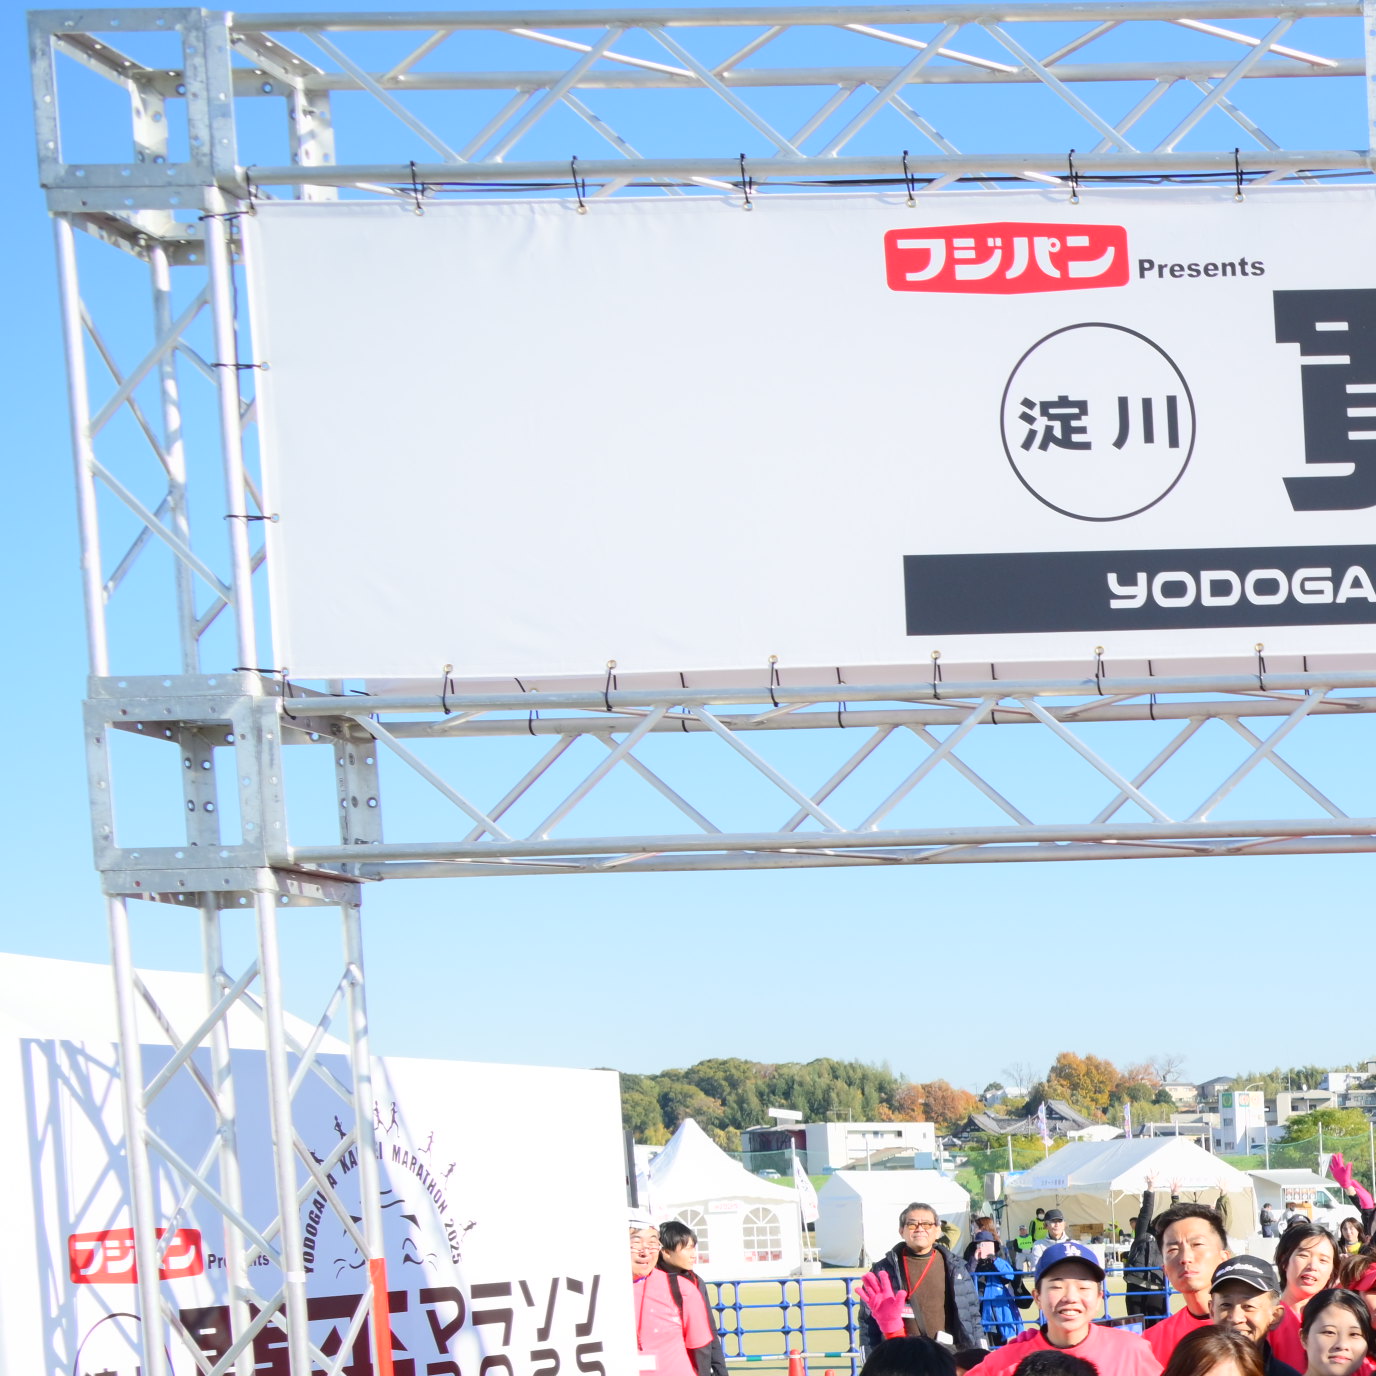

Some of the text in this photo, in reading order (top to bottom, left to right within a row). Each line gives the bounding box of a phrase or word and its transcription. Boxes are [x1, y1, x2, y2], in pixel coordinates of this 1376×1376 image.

[896, 236, 1266, 281] フジパン Presents
[1017, 393, 1181, 454] 淀川
[303, 1172, 338, 1274] YODOGAA
[391, 1143, 448, 1215] MARATHON
[443, 1217, 462, 1265] 2025
[75, 1236, 197, 1277] フジン
